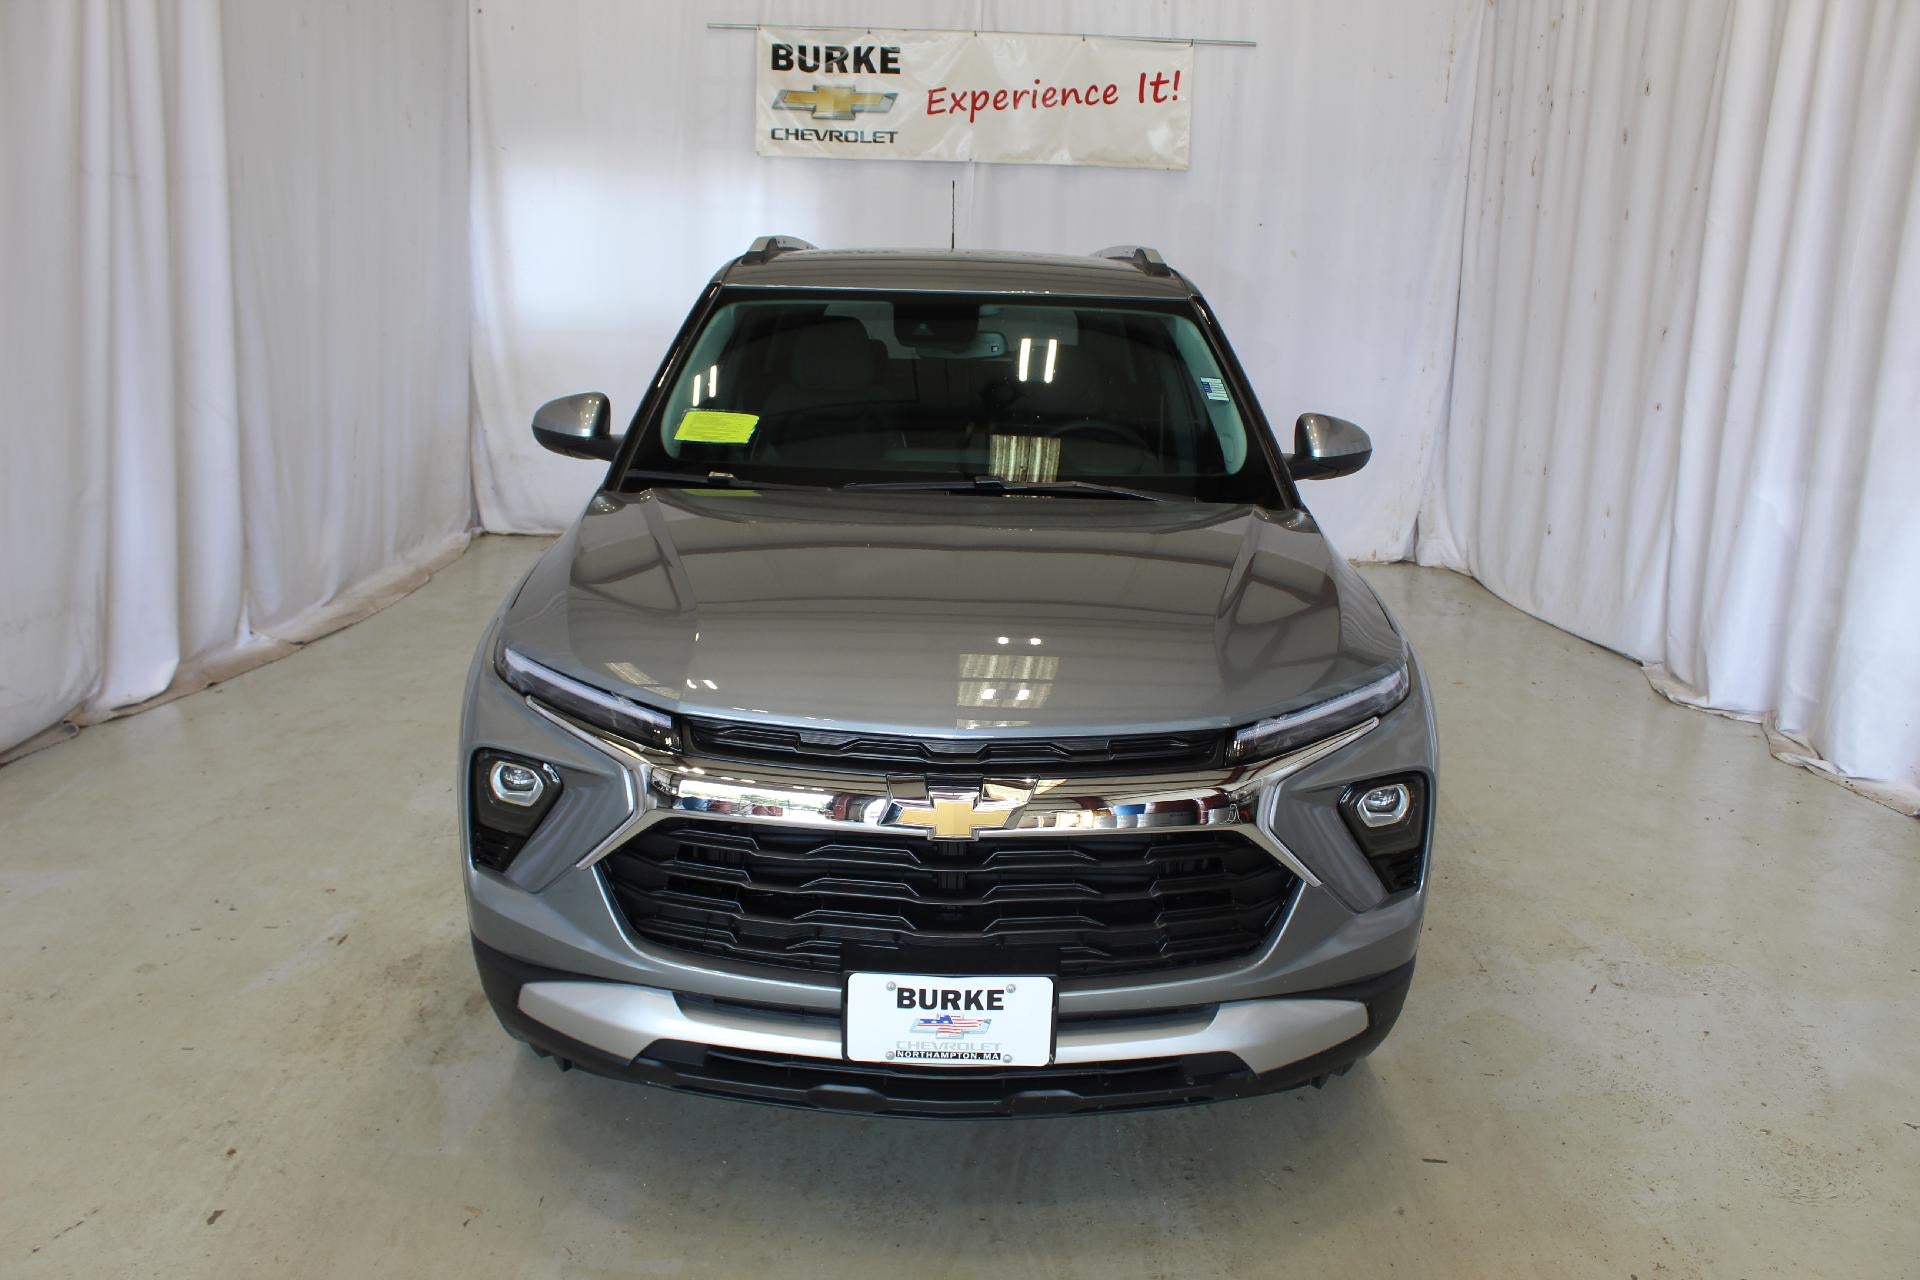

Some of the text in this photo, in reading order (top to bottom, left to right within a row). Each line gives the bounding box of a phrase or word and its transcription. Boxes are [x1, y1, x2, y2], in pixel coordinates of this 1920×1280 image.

[771, 44, 901, 75] BURKE
[926, 70, 1181, 123] Experience It!
[771, 127, 898, 144] CHEVROLET
[897, 987, 1004, 1010] BURKE
[897, 1041, 1001, 1051] CHEVROLET
